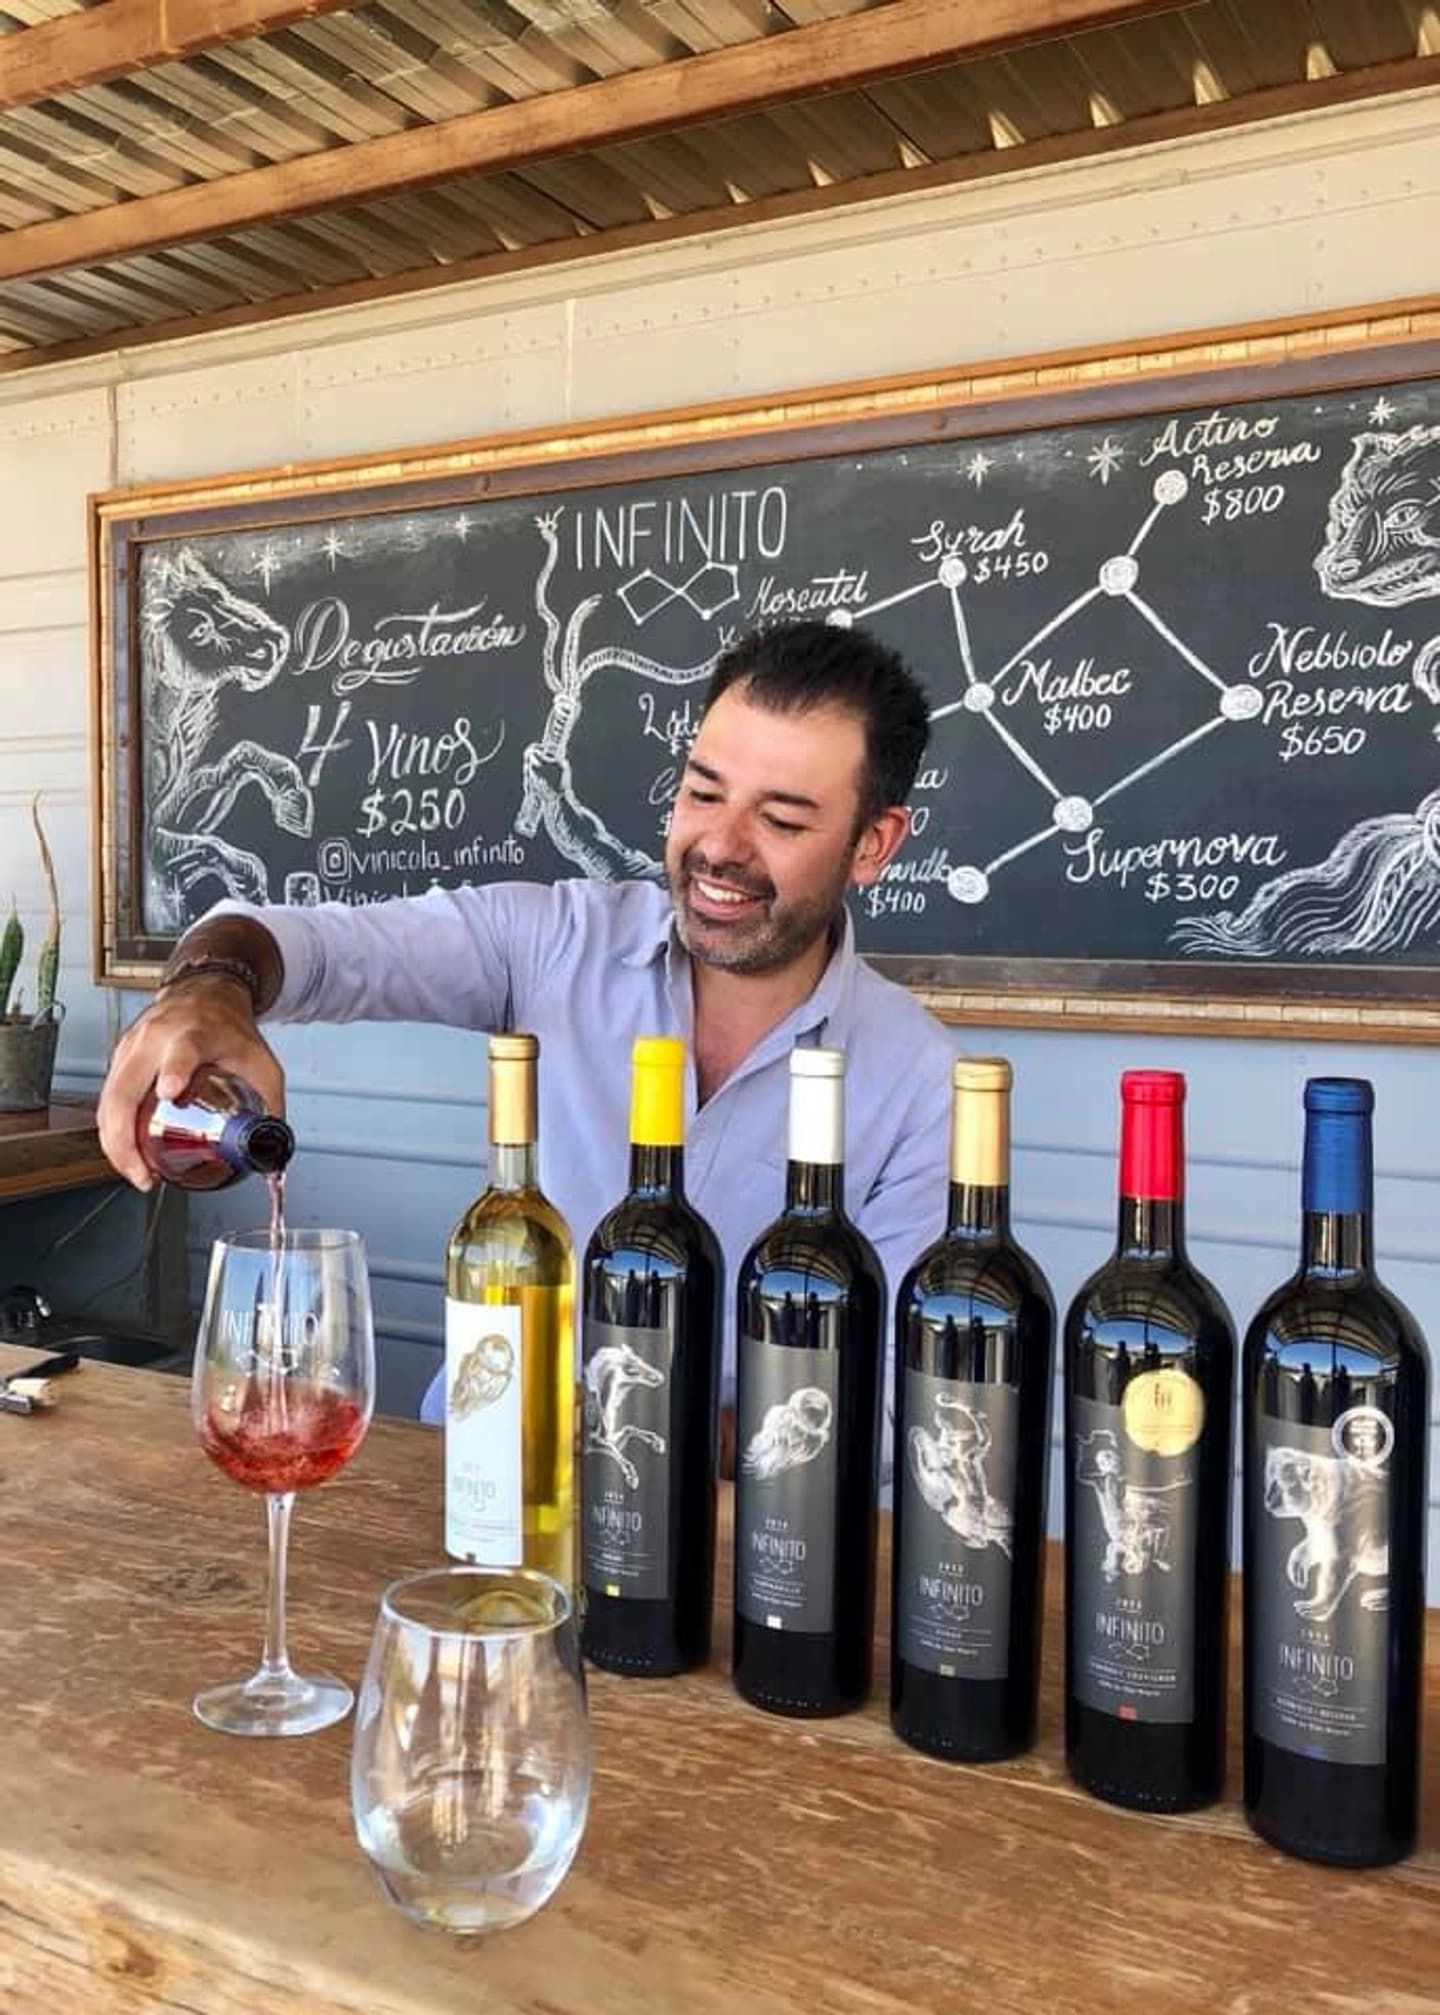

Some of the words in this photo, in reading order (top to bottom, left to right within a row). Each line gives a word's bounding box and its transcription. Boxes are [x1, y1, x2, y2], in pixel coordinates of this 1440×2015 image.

[1192, 442, 1321, 486] Reserva
[1201, 484, 1285, 526] $800
[575, 486, 788, 572] INFINITO
[911, 508, 1025, 562] Syrah
[973, 551, 1049, 584] $450
[1249, 622, 1413, 678] Nebbiolo
[1002, 657, 1132, 706] Malbec
[1262, 680, 1412, 725] Reserva
[1043, 703, 1112, 736] $400
[295, 701, 352, 787] 4
[366, 717, 505, 785] Vinos
[1279, 722, 1366, 763] $650
[356, 788, 466, 838] $250
[1063, 828, 1287, 889] Supernova
[864, 885, 926, 919] $400
[1144, 872, 1239, 903] $300
[1095, 1611, 1165, 1645] INFINITO
[1278, 1643, 1354, 1681] INFINITO
